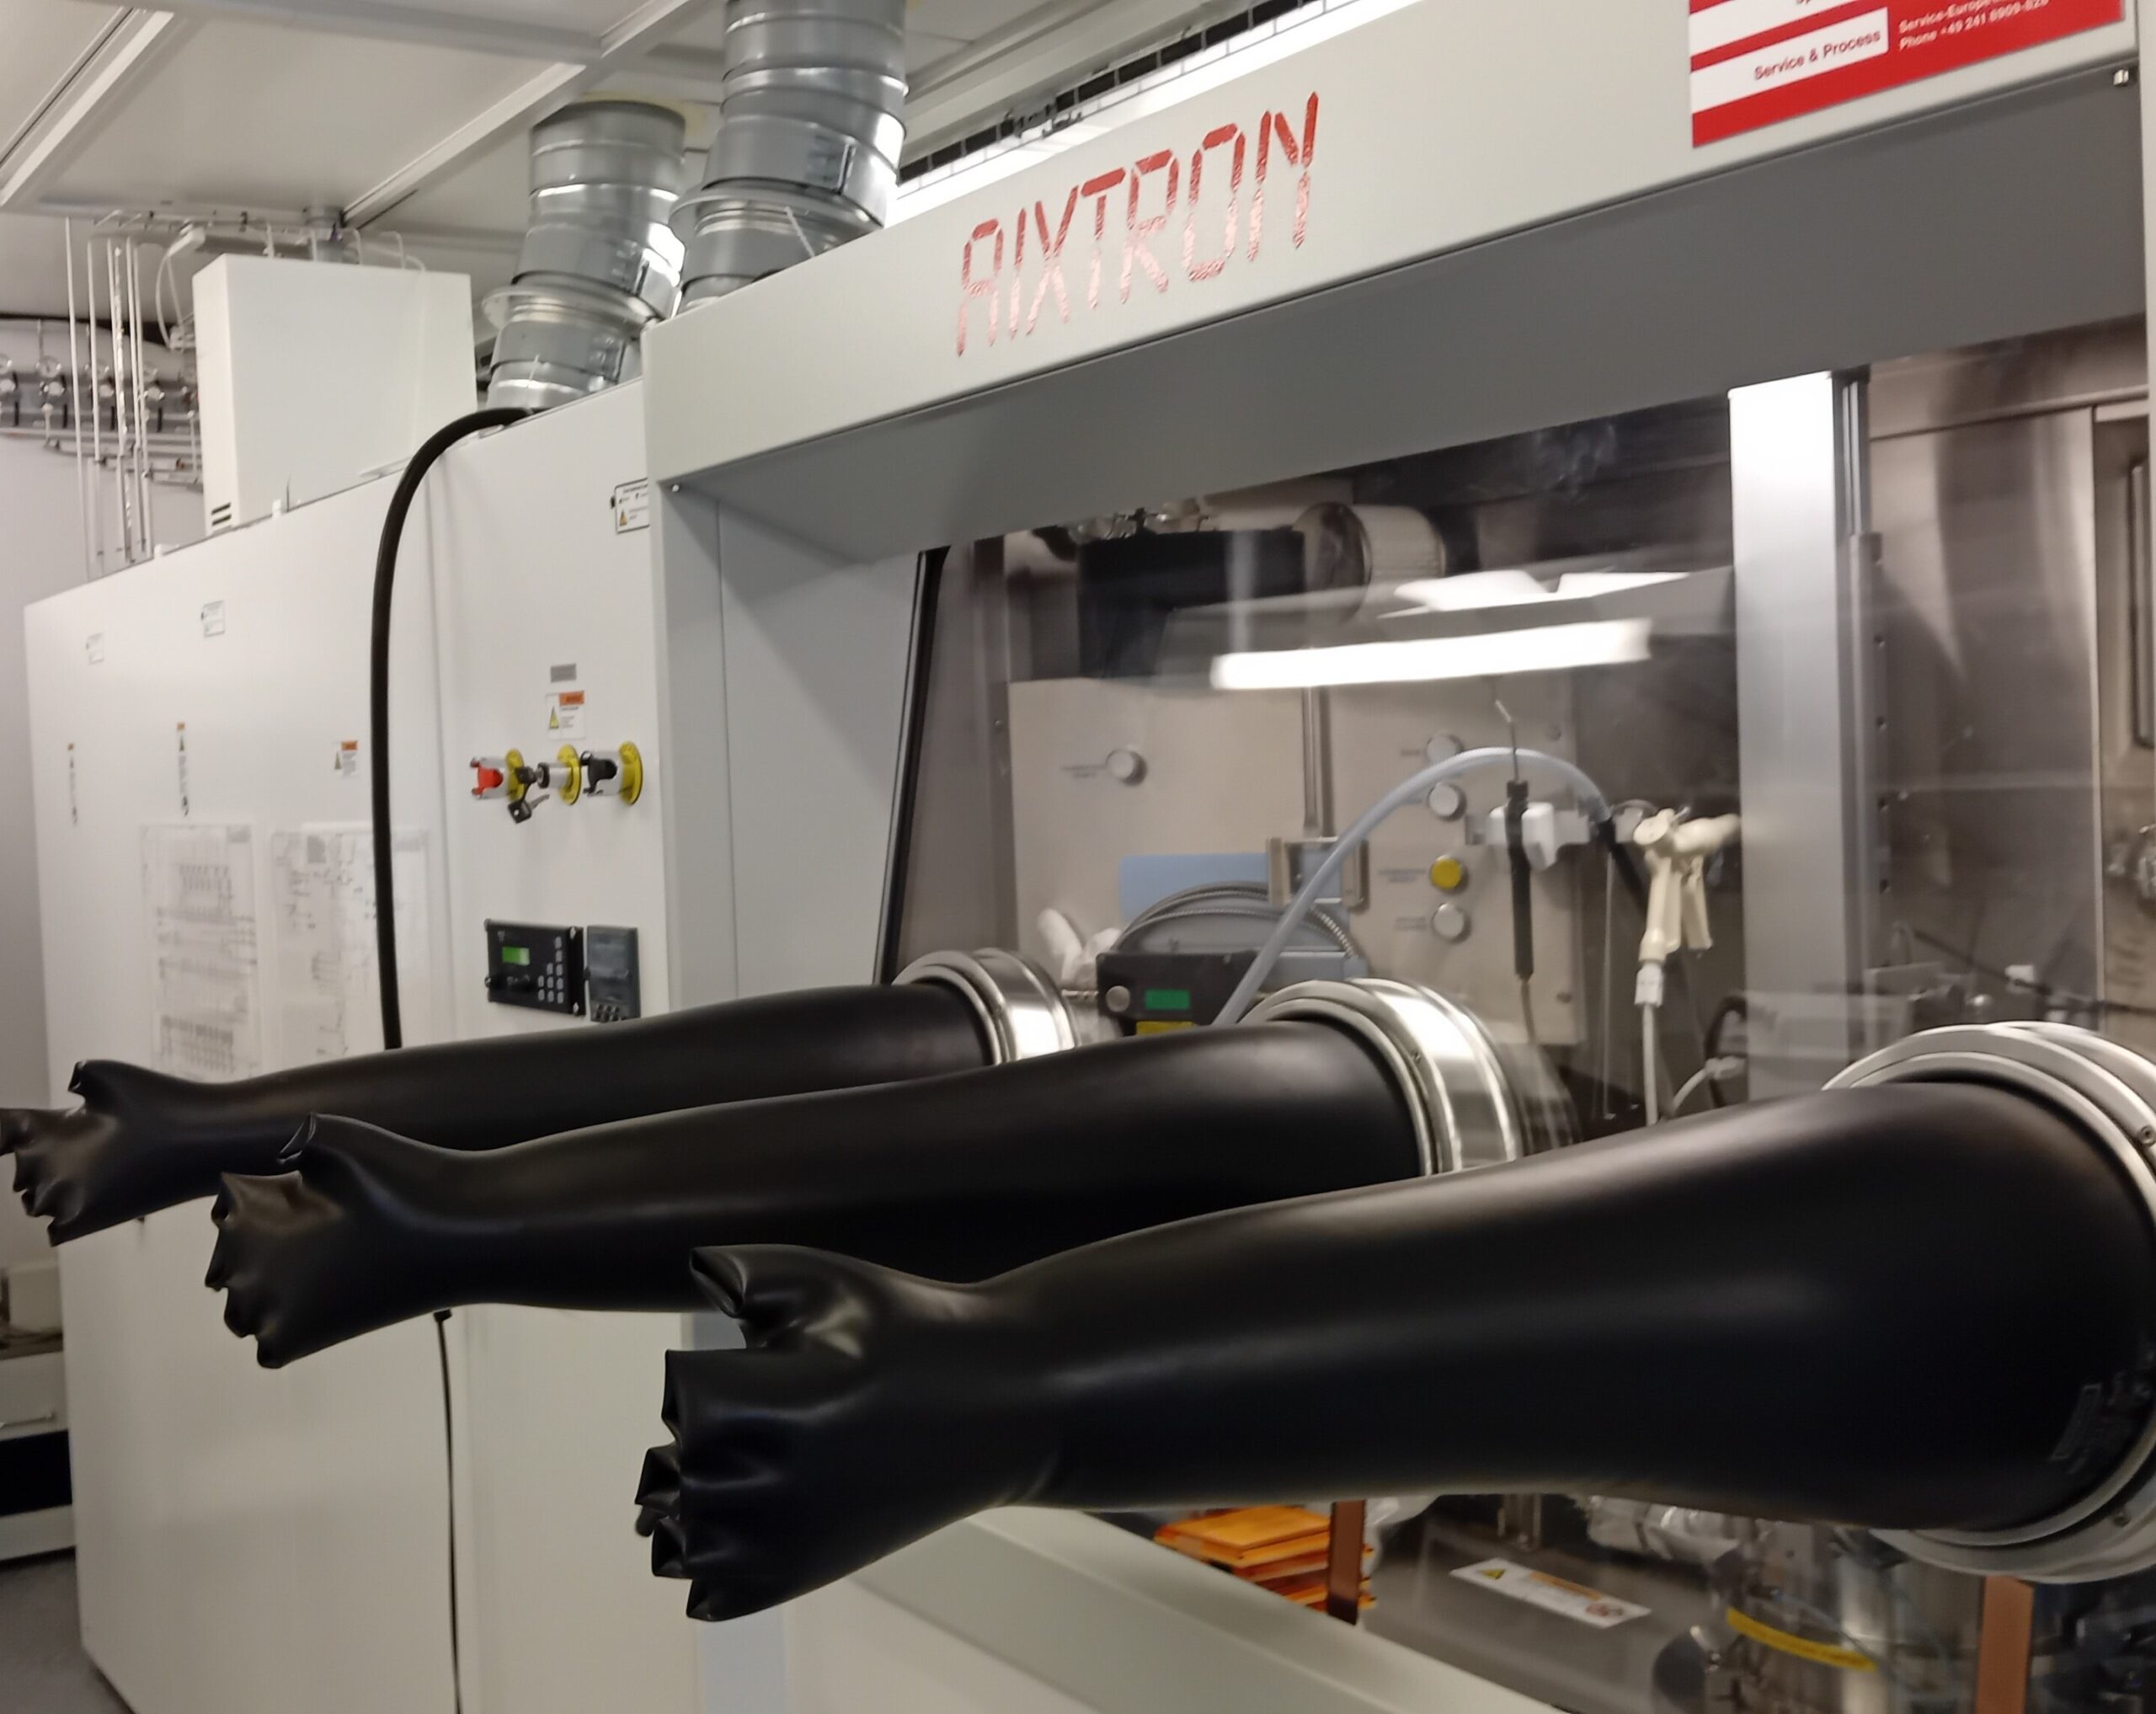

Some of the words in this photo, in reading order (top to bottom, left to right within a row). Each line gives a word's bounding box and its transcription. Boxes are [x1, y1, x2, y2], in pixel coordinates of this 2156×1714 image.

[1754, 55, 1804, 80] Service
[1809, 48, 1818, 63] &
[1823, 30, 1881, 58] Process
[1900, 29, 1937, 51] Phone
[1964, 13, 1987, 30] 241
[957, 91, 1319, 356] AIXTRON
